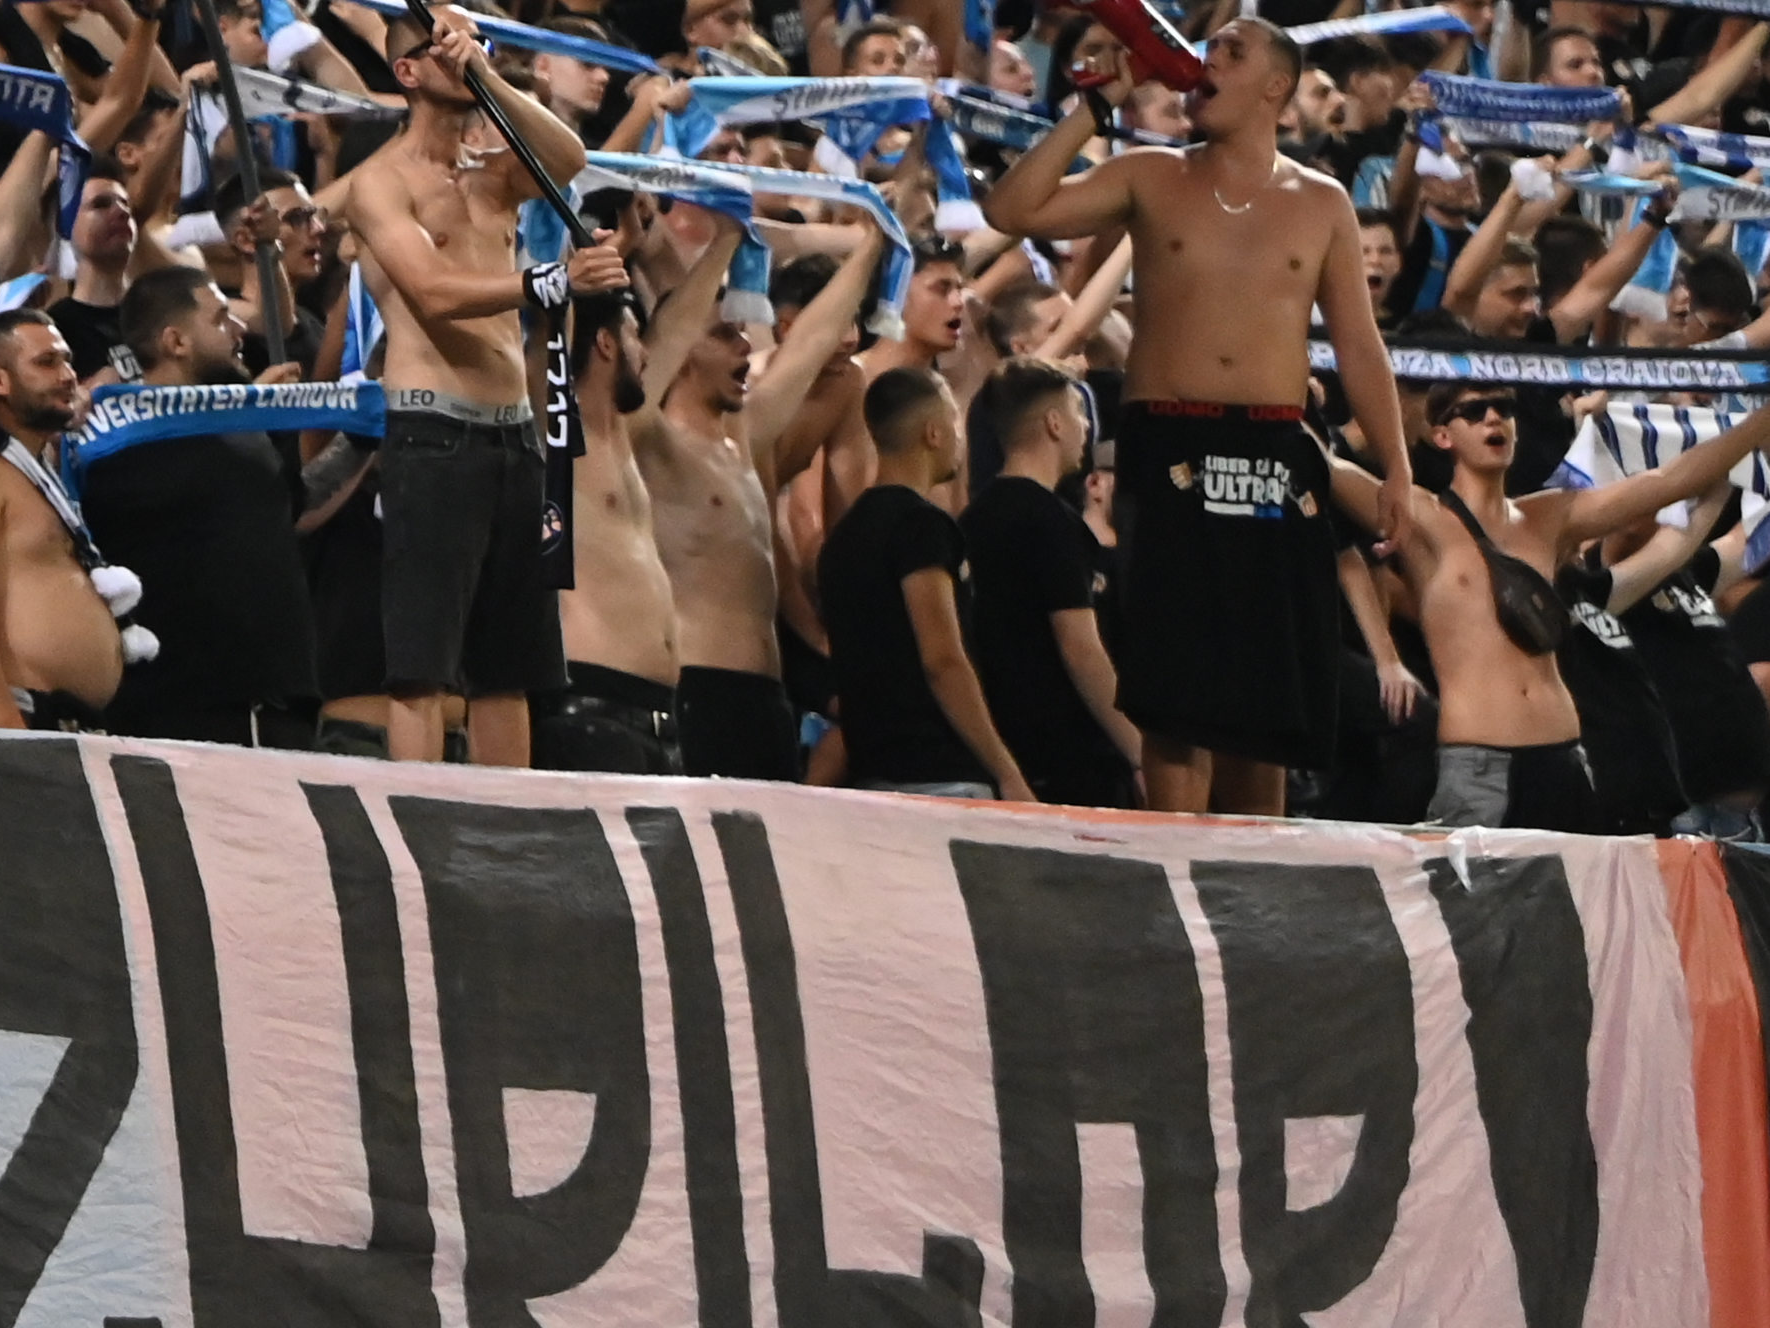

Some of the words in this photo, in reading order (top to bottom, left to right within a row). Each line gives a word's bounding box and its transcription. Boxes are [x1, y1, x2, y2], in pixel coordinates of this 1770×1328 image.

[1466, 352, 1571, 385] NORD
[399, 389, 435, 409] LEO
[1204, 454, 1251, 475] LIBER
